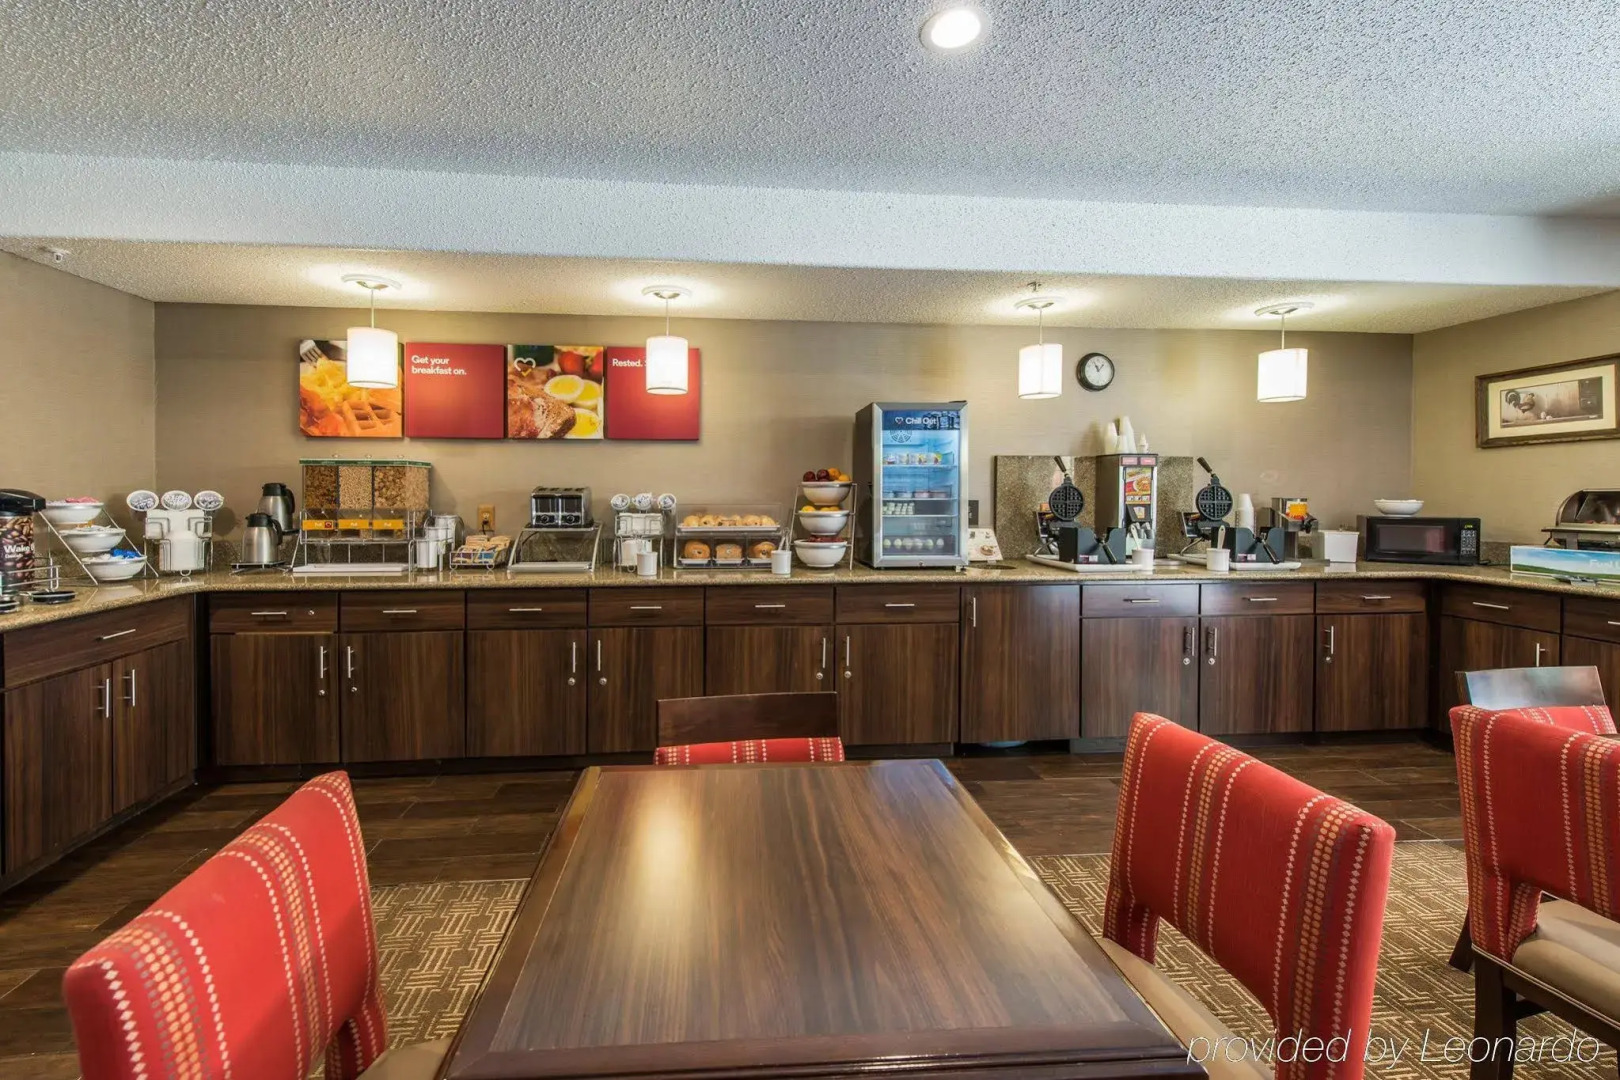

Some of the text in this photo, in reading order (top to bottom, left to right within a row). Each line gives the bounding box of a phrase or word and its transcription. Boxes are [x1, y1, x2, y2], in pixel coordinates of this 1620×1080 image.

[411, 355, 450, 366] Get your
[612, 358, 643, 367] Rested.
[411, 365, 452, 375] breakfast
[905, 417, 922, 425] Chill
[3, 544, 30, 553] Wake
